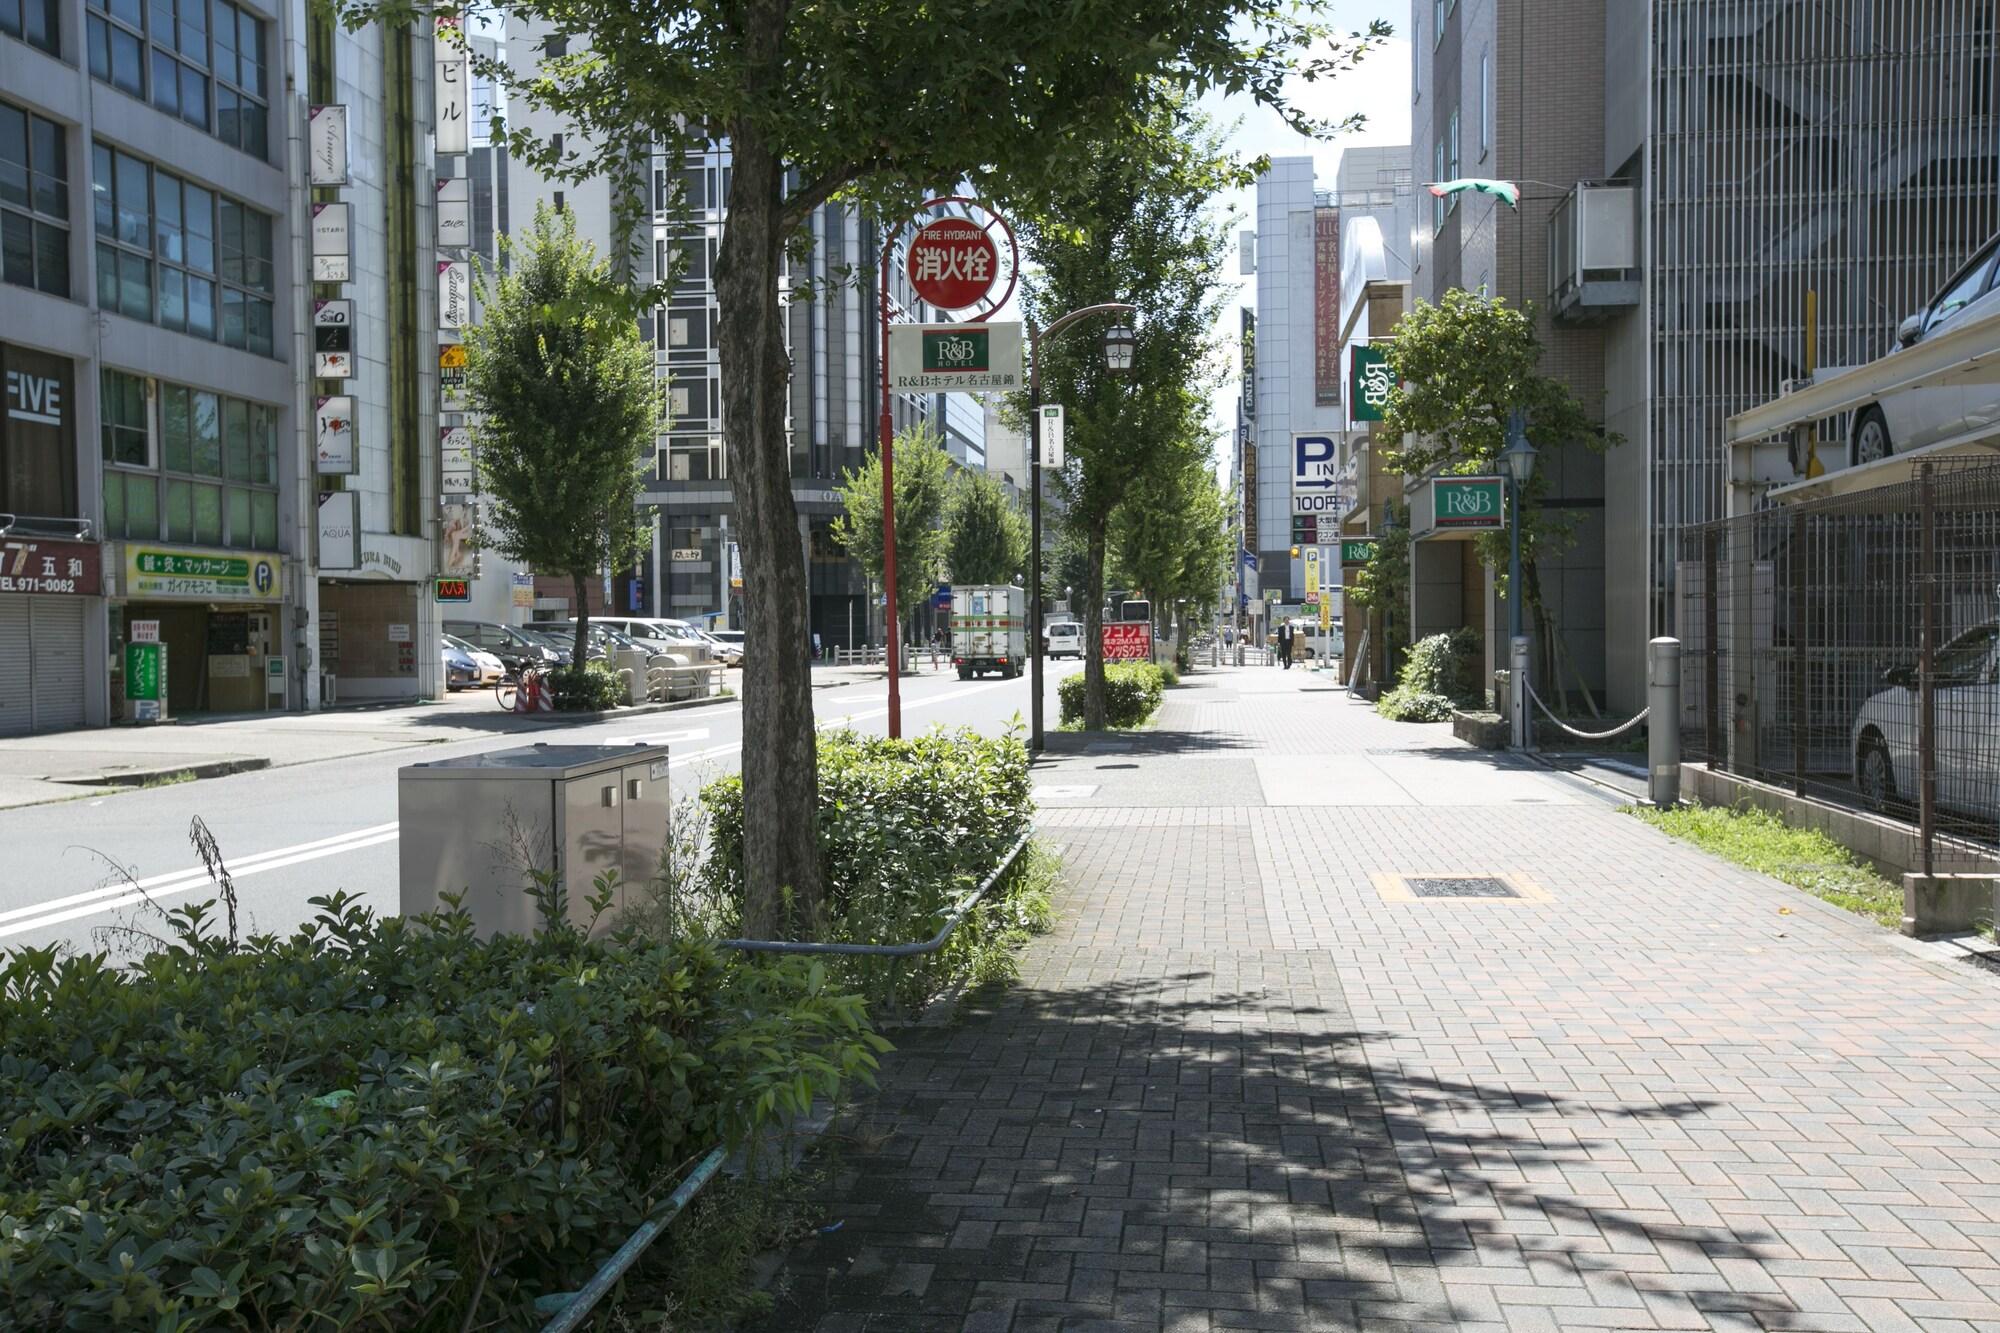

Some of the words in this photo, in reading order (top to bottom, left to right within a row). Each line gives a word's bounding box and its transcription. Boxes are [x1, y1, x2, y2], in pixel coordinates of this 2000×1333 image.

[922, 230, 942, 241] FIRE
[944, 230, 983, 241] HYDRANT
[915, 246, 991, 282] 消火栓
[937, 340, 975, 361] R&B
[1365, 361, 1389, 405] R&B
[1296, 437, 1335, 476] P
[1317, 464, 1334, 476] IN
[1296, 496, 1337, 511] 100円
[1446, 490, 1491, 515] R&B
[42, 556, 83, 577] 五和
